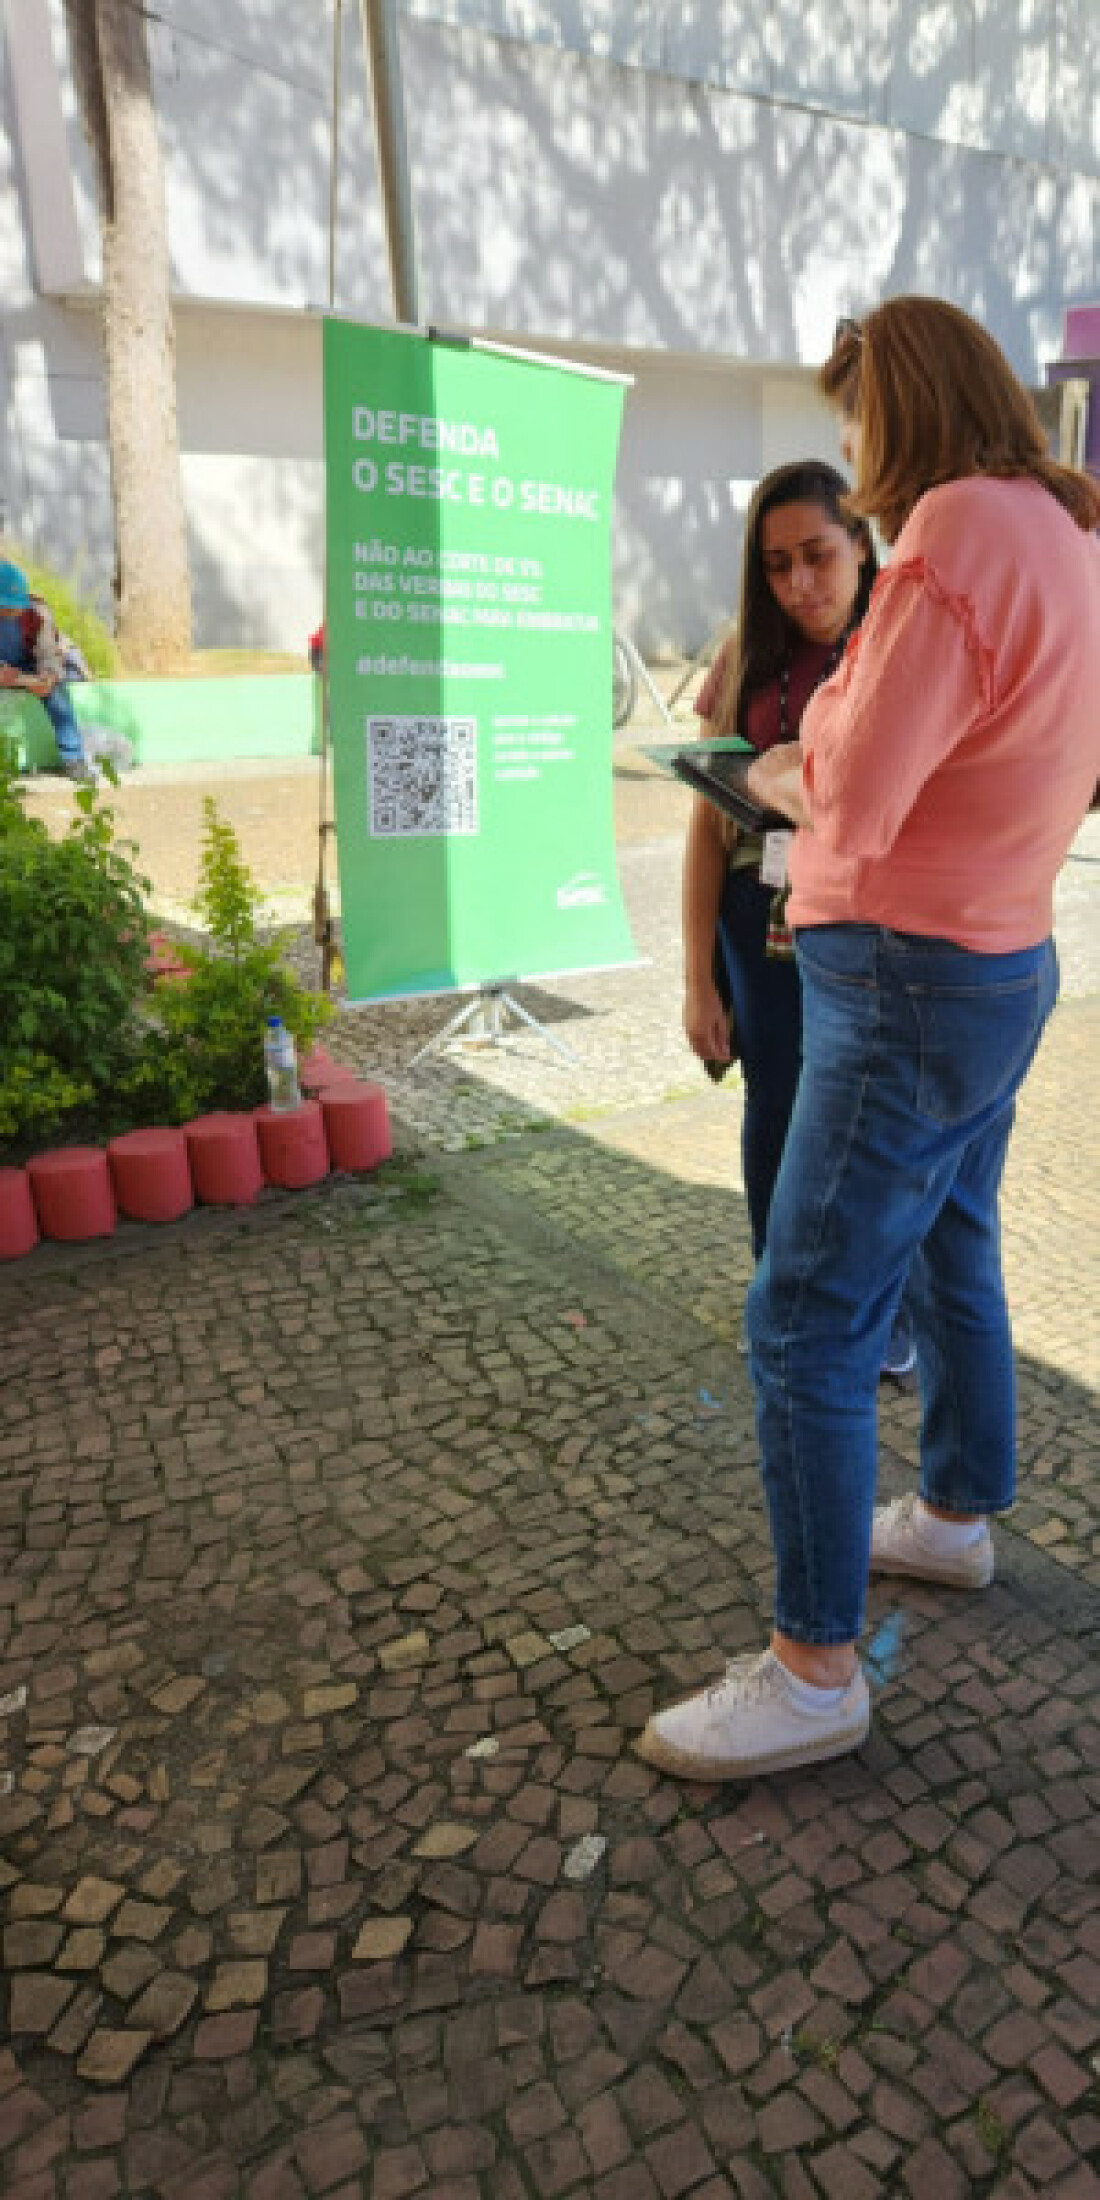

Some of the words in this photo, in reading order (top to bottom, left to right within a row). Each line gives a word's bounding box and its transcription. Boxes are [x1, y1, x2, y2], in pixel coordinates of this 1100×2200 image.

[353, 407, 498, 458] DEFENDA
[353, 459, 377, 491] O
[385, 462, 462, 499] SESC
[469, 475, 484, 504] E
[492, 478, 513, 509] O
[520, 483, 598, 521] SENAC
[354, 540, 396, 564] NÃO
[403, 548, 433, 567] AO
[354, 572, 395, 591] DAS
[355, 598, 365, 619] E
[372, 601, 403, 621] DO
